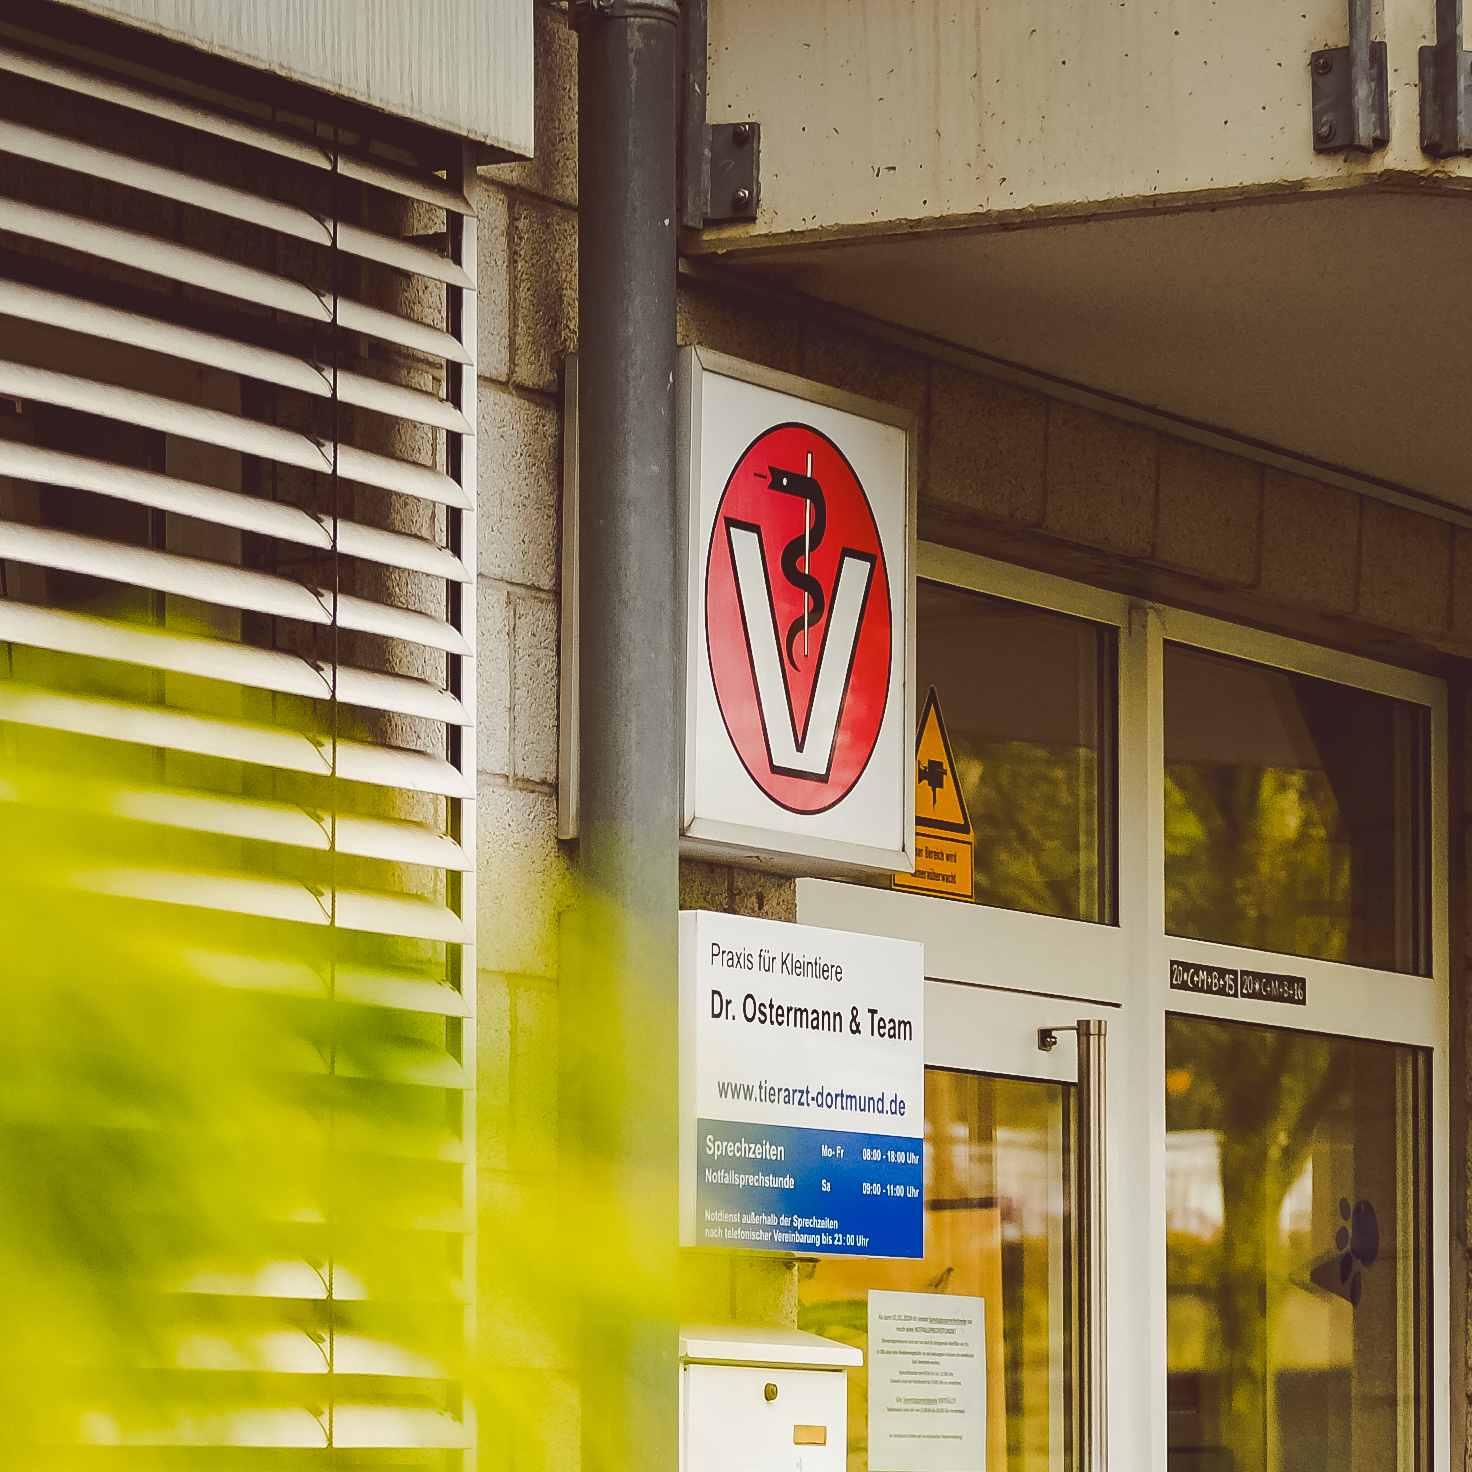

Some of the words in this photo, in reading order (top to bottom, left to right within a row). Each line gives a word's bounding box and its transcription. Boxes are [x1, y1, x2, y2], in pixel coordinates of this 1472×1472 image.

[724, 517, 877, 783] V
[925, 846, 944, 861] Bereich
[946, 850, 956, 863] wird
[711, 943, 753, 970] Praxis
[758, 949, 776, 974] für
[781, 952, 843, 982] Kleintiere
[711, 989, 735, 1020] Dr.
[743, 993, 842, 1033] Ostermann
[850, 1006, 861, 1035] &
[868, 1008, 912, 1041] Team
[718, 1080, 906, 1116] www.tierarzt-dortmund.de
[706, 1135, 784, 1161] Sprechzeiten
[836, 1147, 844, 1159] Fr
[863, 1150, 881, 1161] 08:00
[887, 1151, 905, 1163] 18:00
[907, 1152, 919, 1165] Uhr
[705, 1168, 794, 1189] Notfallsprechstunde
[822, 1179, 830, 1192] Sa
[863, 1183, 880, 1195] 09:00
[887, 1184, 904, 1197] 11:00
[907, 1186, 919, 1198] Uhr
[705, 1209, 740, 1224] Notdienst
[742, 1212, 778, 1225] außerhalb
[780, 1214, 791, 1226] der
[793, 1215, 838, 1230] Sprechzeiten
[705, 1227, 722, 1238] nach
[725, 1228, 772, 1241] telefonischer
[774, 1230, 820, 1247] Vereinbarung
[822, 1233, 832, 1245] bis
[834, 1234, 854, 1246] 23:00
[856, 1235, 869, 1247] Uhr
